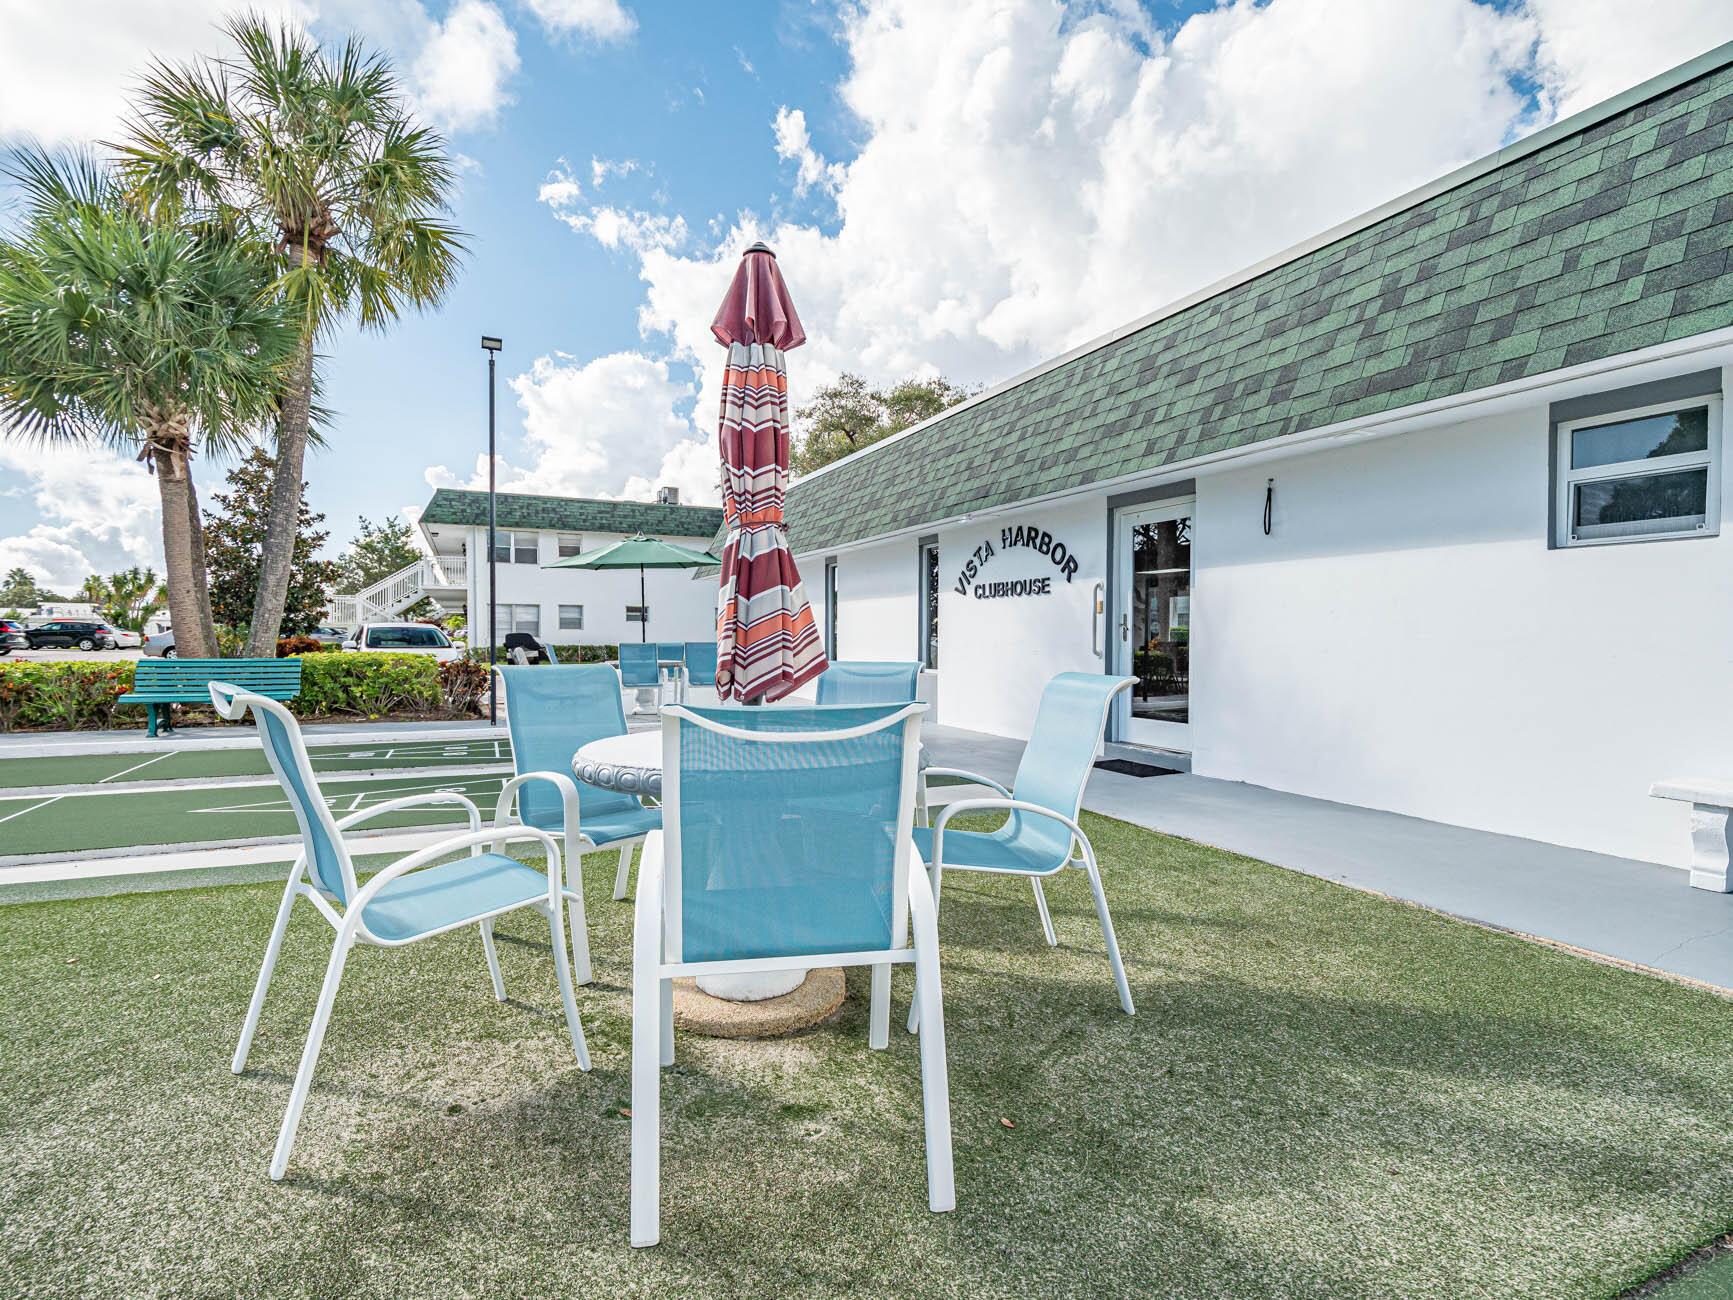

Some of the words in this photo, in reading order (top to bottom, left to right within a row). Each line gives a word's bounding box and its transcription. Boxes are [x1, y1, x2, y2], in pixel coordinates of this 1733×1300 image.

[954, 540, 995, 596] VISTA
[1001, 525, 1079, 583] HARBOR
[974, 577, 1051, 599] CLUBHOUSE
